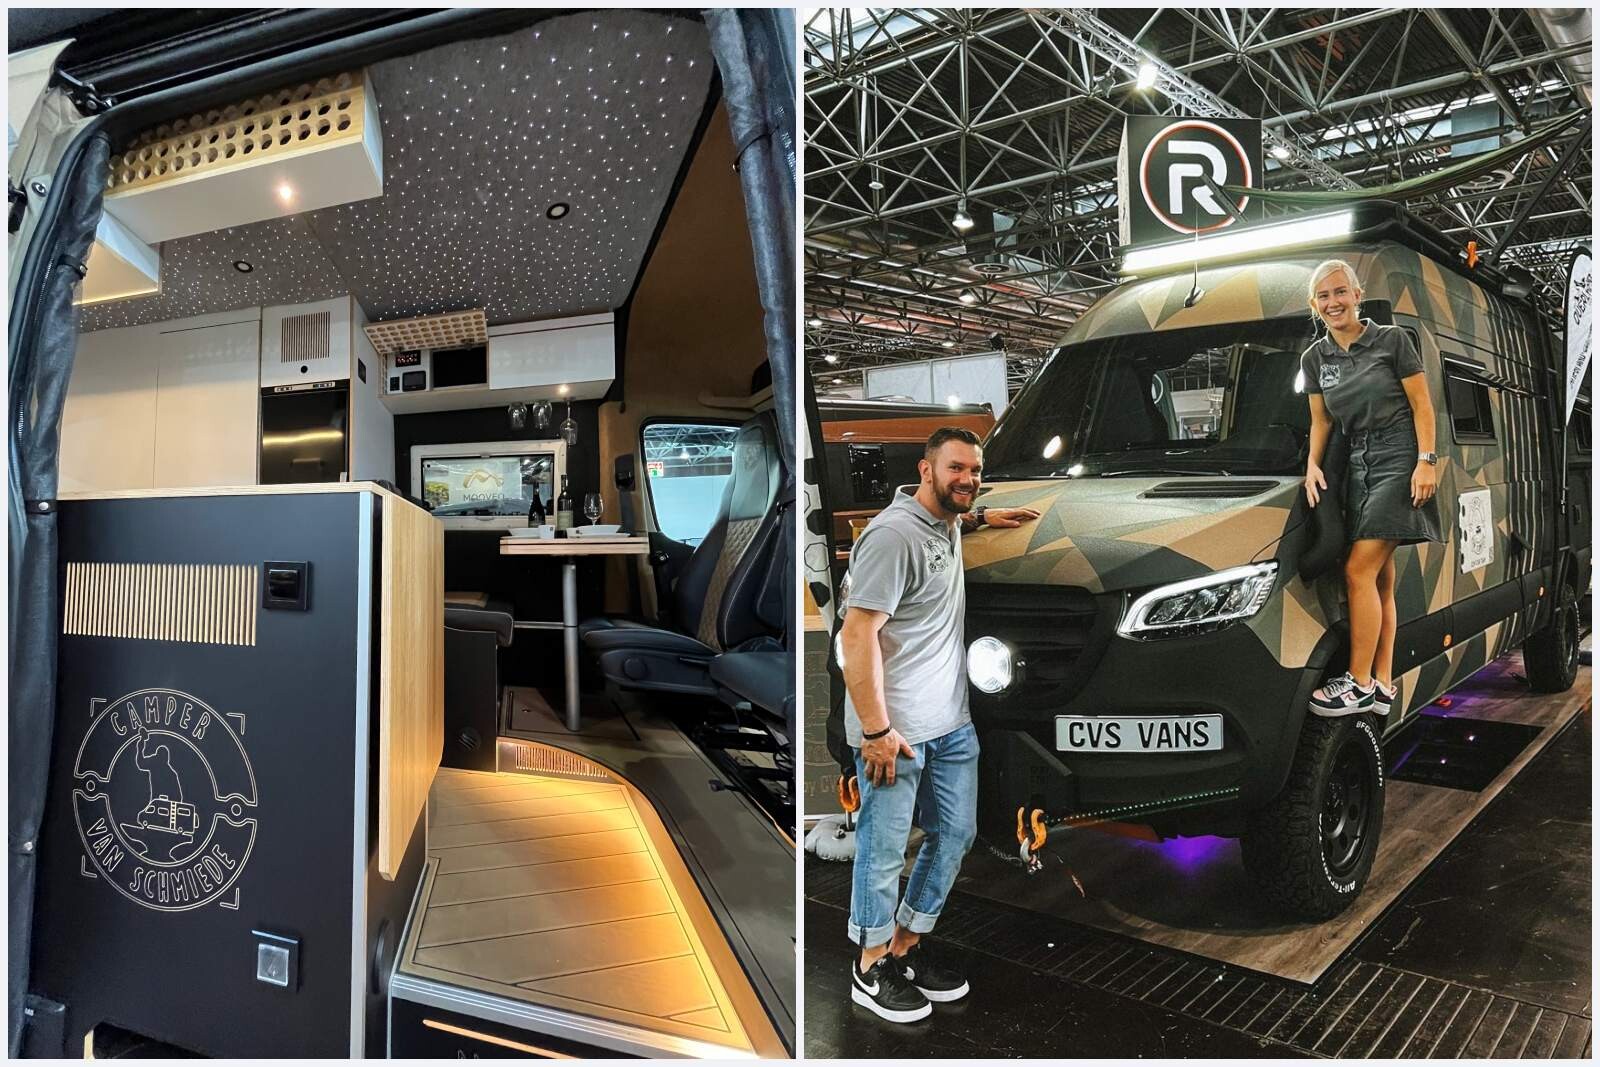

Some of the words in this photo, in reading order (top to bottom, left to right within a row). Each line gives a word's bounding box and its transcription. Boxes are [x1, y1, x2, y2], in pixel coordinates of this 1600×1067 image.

[111, 696, 211, 739] CAMPER
[1069, 722, 1121, 748] CVS
[1138, 721, 1210, 749] VANS
[87, 818, 124, 872] VAN
[129, 844, 236, 903] SCHMIEDE
